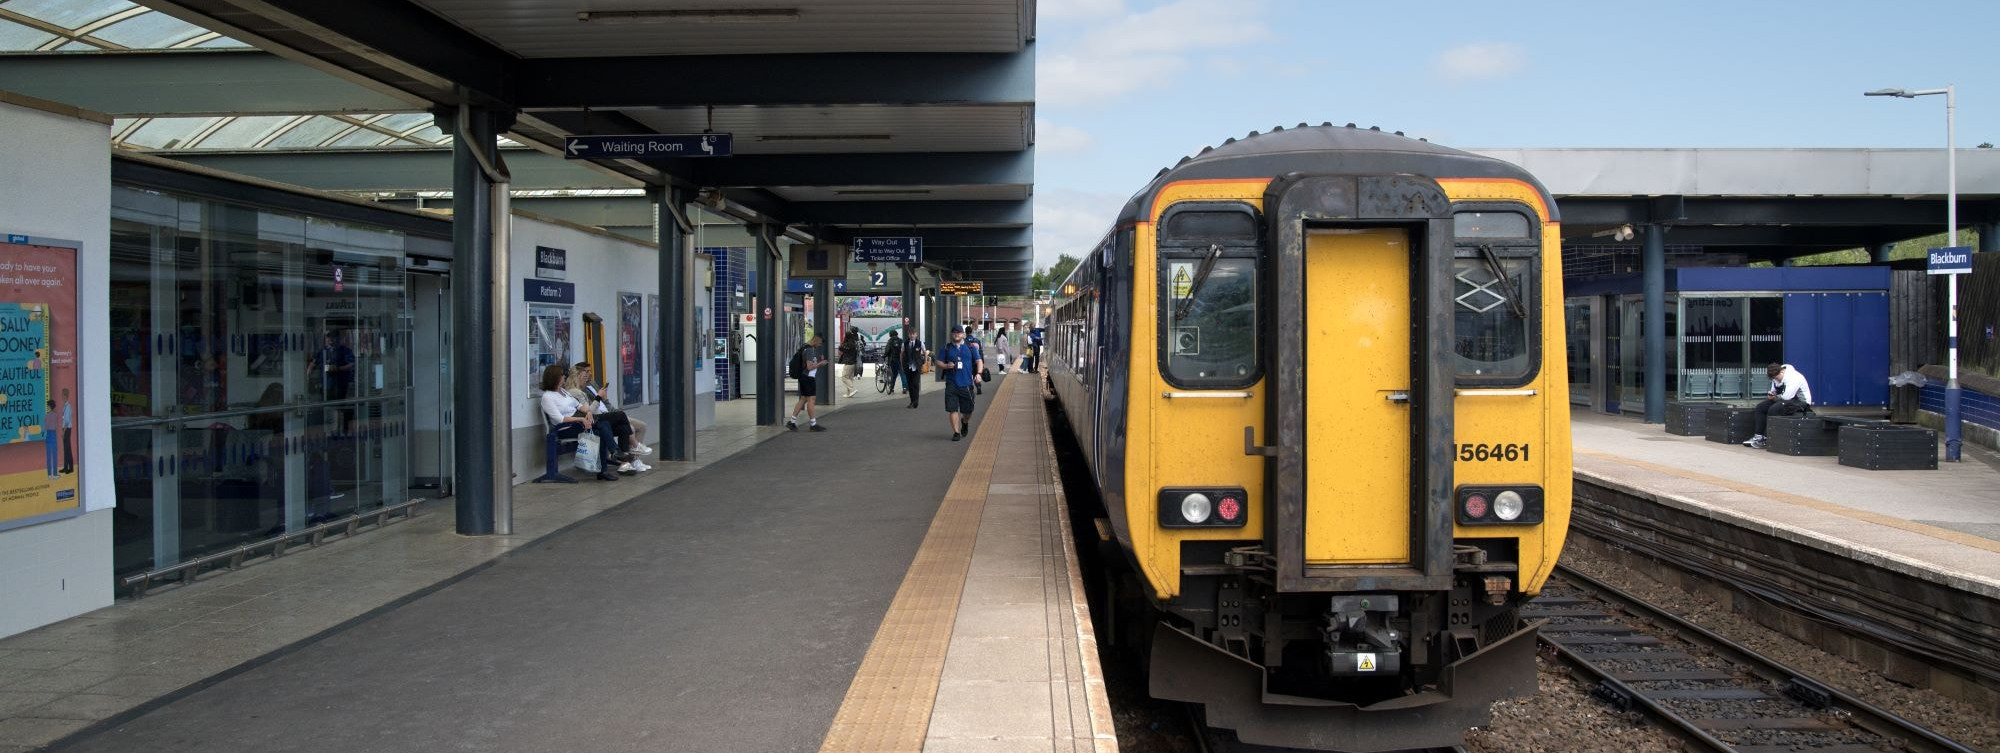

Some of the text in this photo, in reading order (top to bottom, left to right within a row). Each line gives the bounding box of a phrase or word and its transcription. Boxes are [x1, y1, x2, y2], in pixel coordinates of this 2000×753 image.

[602, 141, 683, 154] Waiting Room
[541, 251, 564, 266] Blackburn
[1930, 252, 1967, 265] Blackburn
[0, 260, 57, 274] ady to have your
[15, 275, 24, 285] all
[24, 278, 40, 286] over
[874, 271, 884, 286] 2
[541, 286, 558, 297] Platform
[1, 316, 31, 332] SALLY
[0, 414, 40, 430] RE YOU
